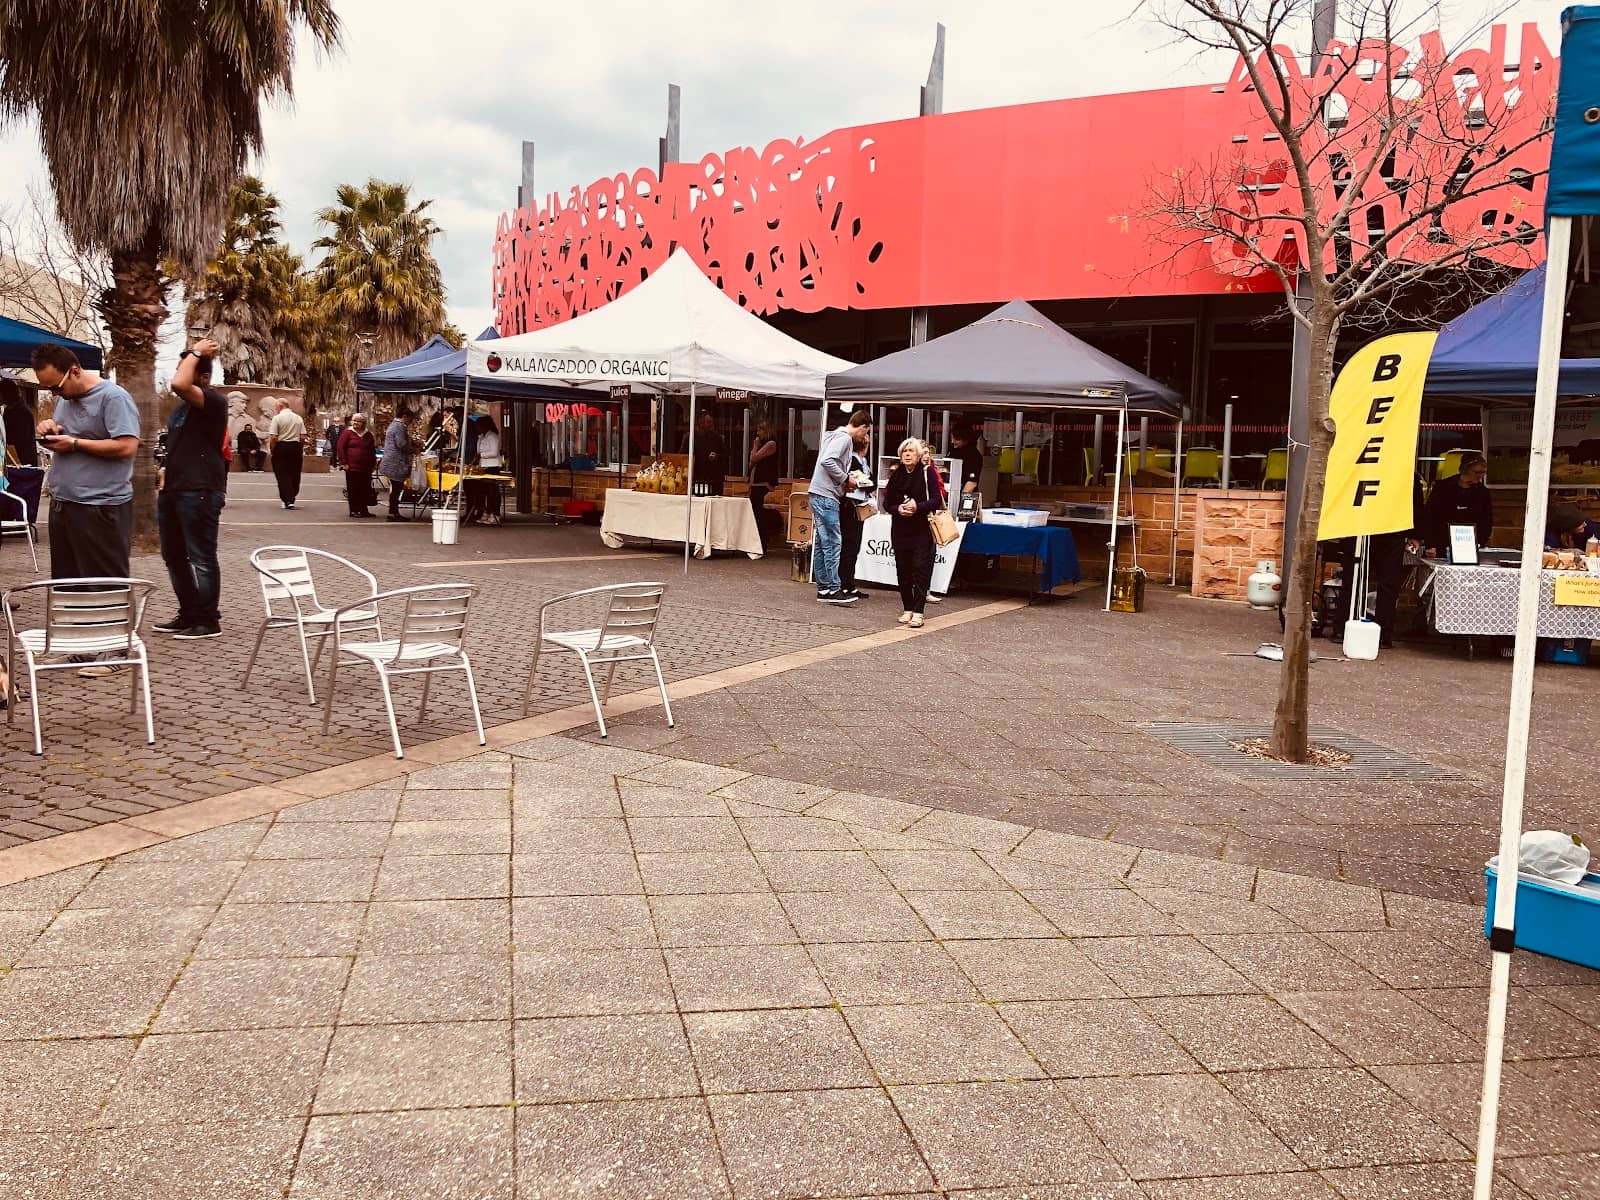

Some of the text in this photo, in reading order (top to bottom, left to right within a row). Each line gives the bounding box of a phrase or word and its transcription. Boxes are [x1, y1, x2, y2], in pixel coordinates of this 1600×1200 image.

[505, 357, 669, 376] KALANGADOO ORGANIC
[610, 386, 629, 399] juice
[718, 388, 749, 400] vinegar
[1352, 353, 1402, 508] BEEF
